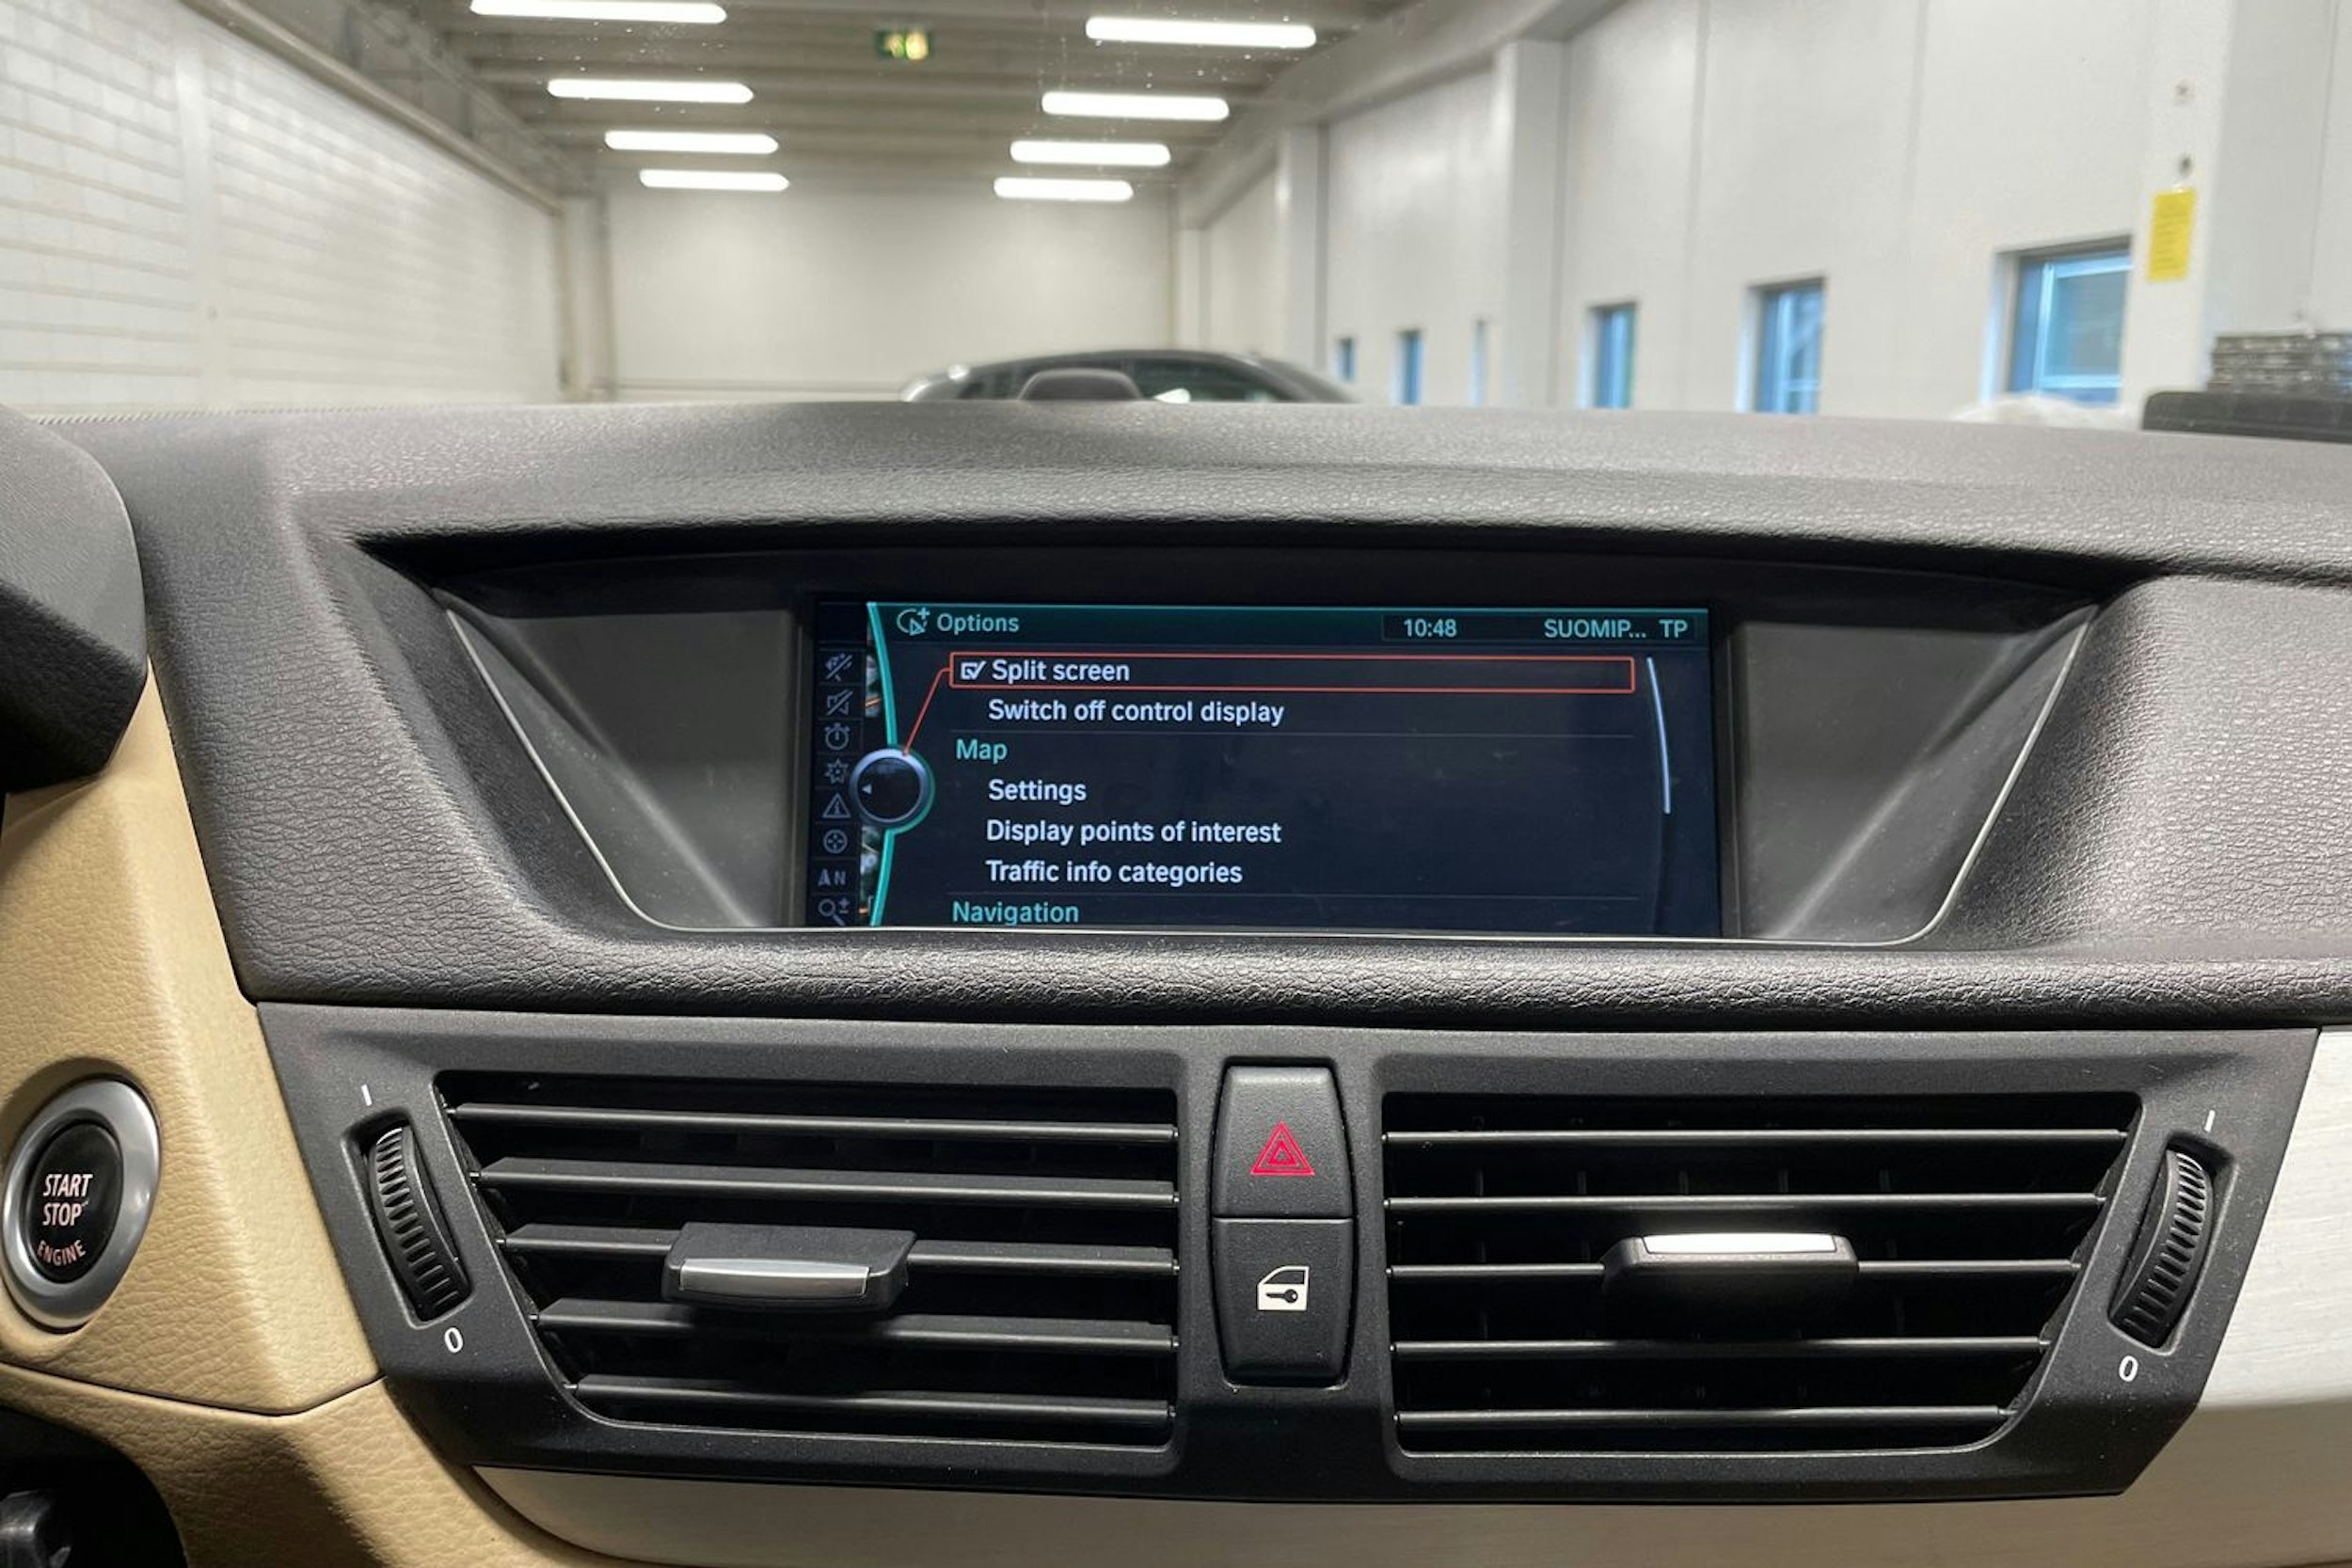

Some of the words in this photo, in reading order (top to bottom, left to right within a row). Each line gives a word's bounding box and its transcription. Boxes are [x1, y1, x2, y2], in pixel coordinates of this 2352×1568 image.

[937, 613, 1019, 634] Options
[1404, 619, 1457, 637] 10:48
[1544, 620, 1646, 639] SUOMIP...
[1660, 620, 1688, 638] TP
[992, 660, 1046, 683] Split
[1053, 662, 1130, 681] screen
[988, 701, 1066, 721] Switch
[1073, 702, 1105, 721] off
[1112, 702, 1193, 721] control
[1200, 702, 1285, 726] display
[956, 740, 1008, 763] Map
[988, 780, 1087, 803] Settings
[987, 820, 1073, 845] Display
[1081, 821, 1154, 845] points
[1161, 821, 1185, 842] of
[1191, 821, 1281, 844] interest
[986, 861, 1058, 881] Traffic
[1066, 861, 1110, 881] info
[1118, 863, 1243, 887] categories
[953, 901, 1079, 925] Navigation
[42, 1173, 93, 1197] START
[42, 1201, 84, 1226] STOP
[38, 1240, 86, 1266] ENGINE
